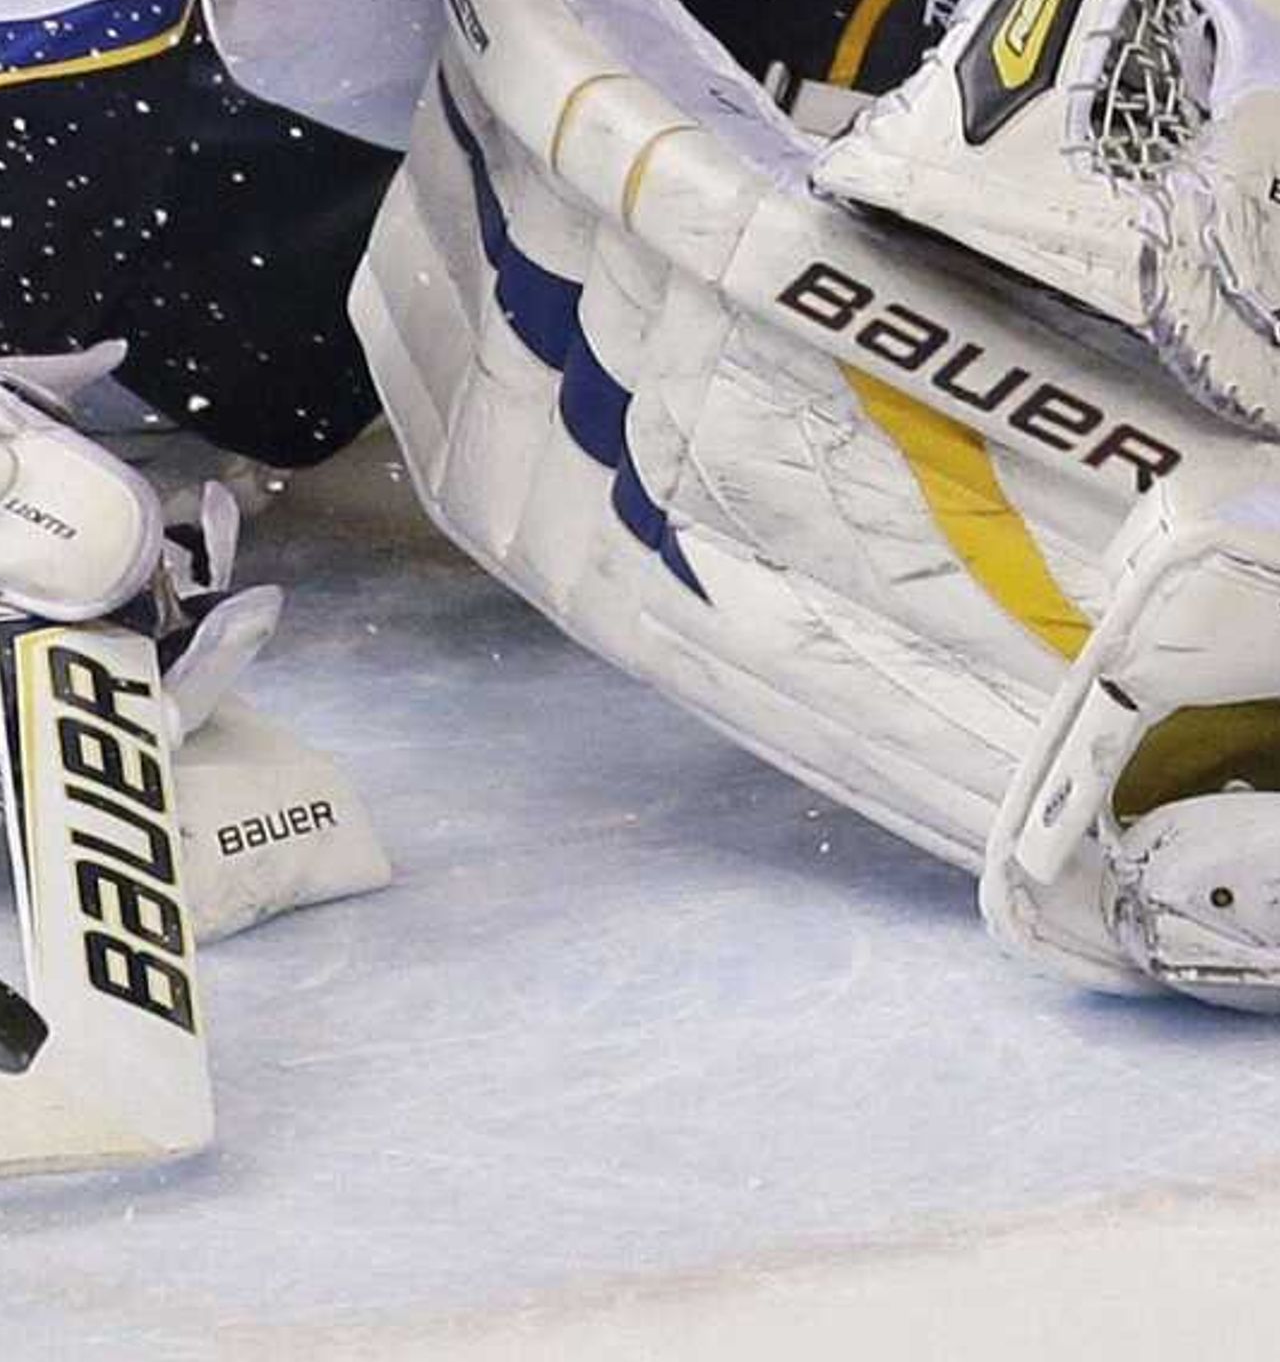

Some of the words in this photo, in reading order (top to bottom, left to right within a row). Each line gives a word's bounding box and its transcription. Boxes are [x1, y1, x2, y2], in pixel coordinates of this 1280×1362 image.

[776, 261, 1182, 494] BAUER
[48, 646, 197, 1037] BAUER
[217, 800, 337, 857] BAUER
